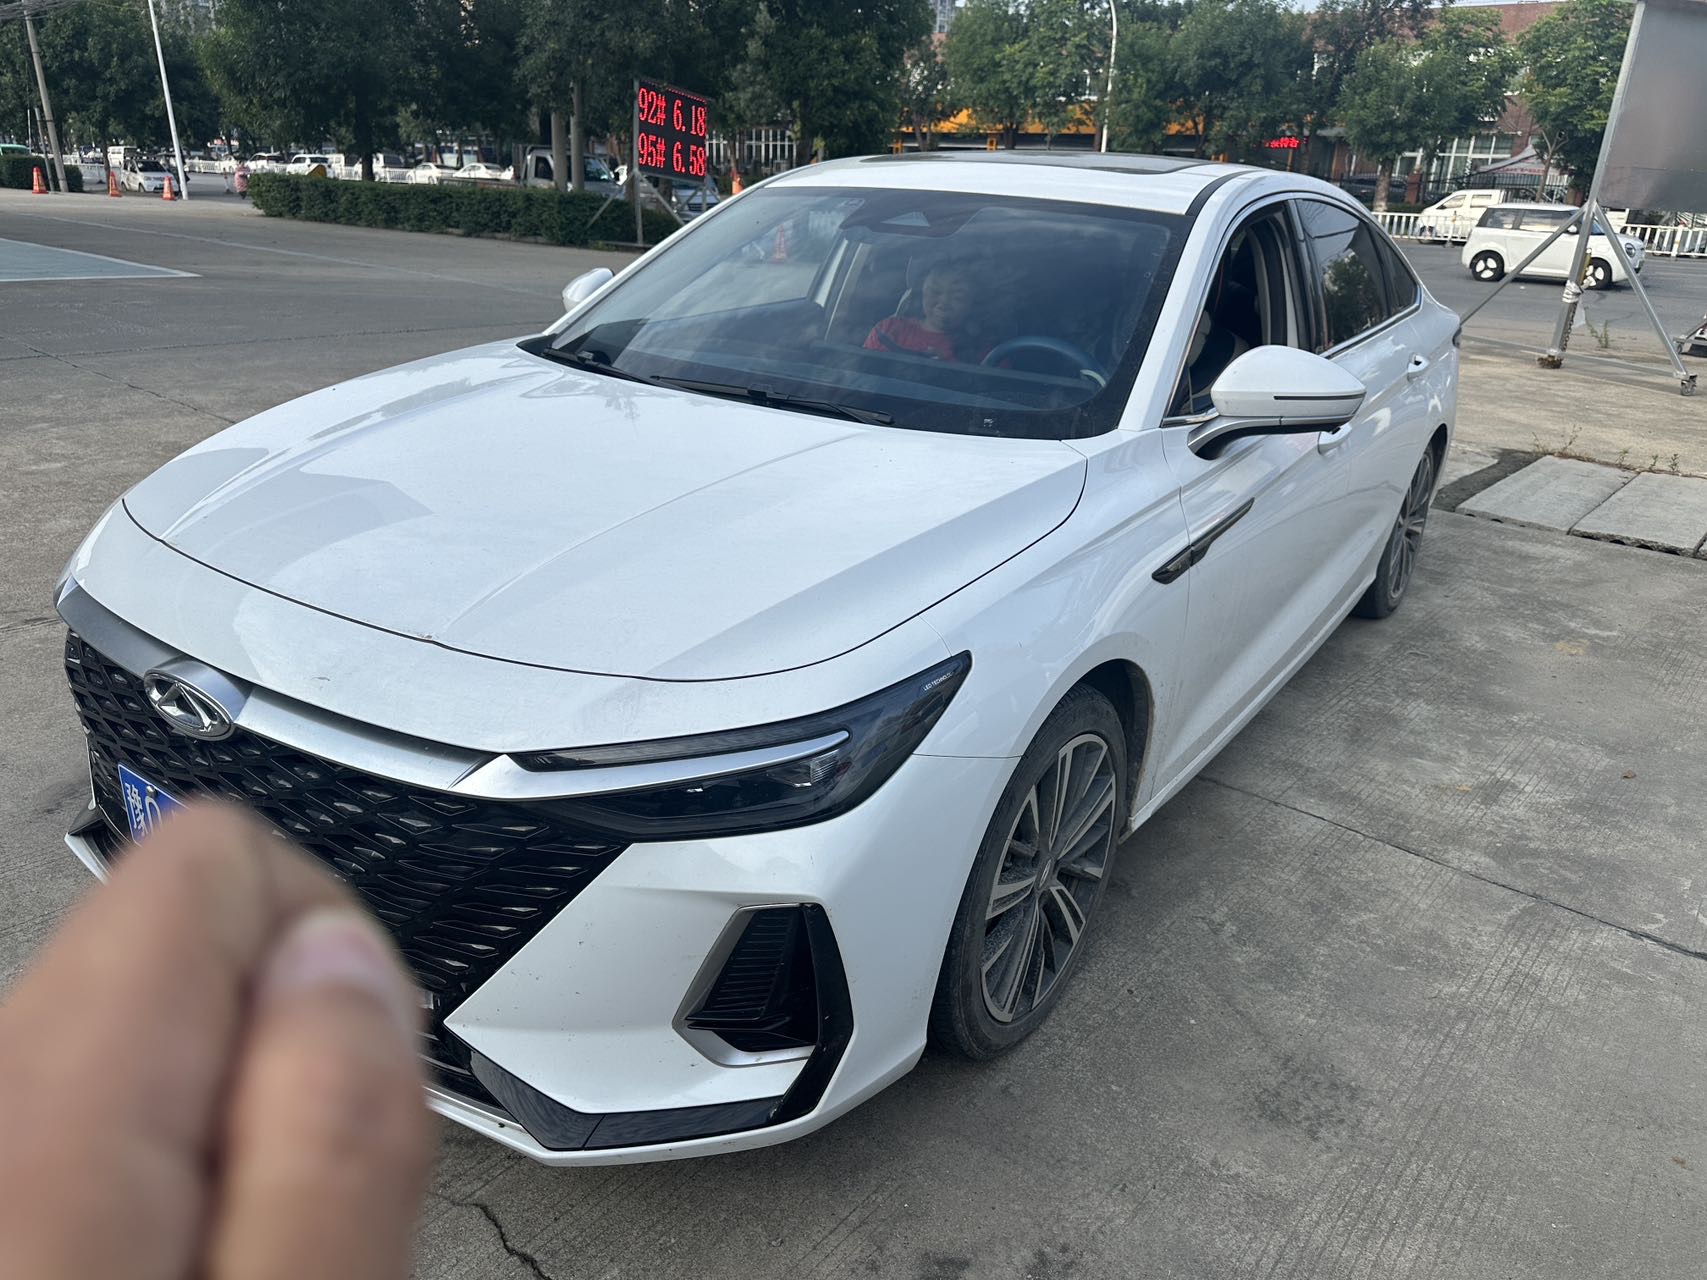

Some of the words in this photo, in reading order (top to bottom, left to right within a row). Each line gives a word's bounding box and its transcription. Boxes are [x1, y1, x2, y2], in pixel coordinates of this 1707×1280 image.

[639, 88, 666, 126] 92#
[673, 99, 705, 137] 6.18
[638, 132, 666, 168] 95#
[673, 141, 705, 176] 6.58
